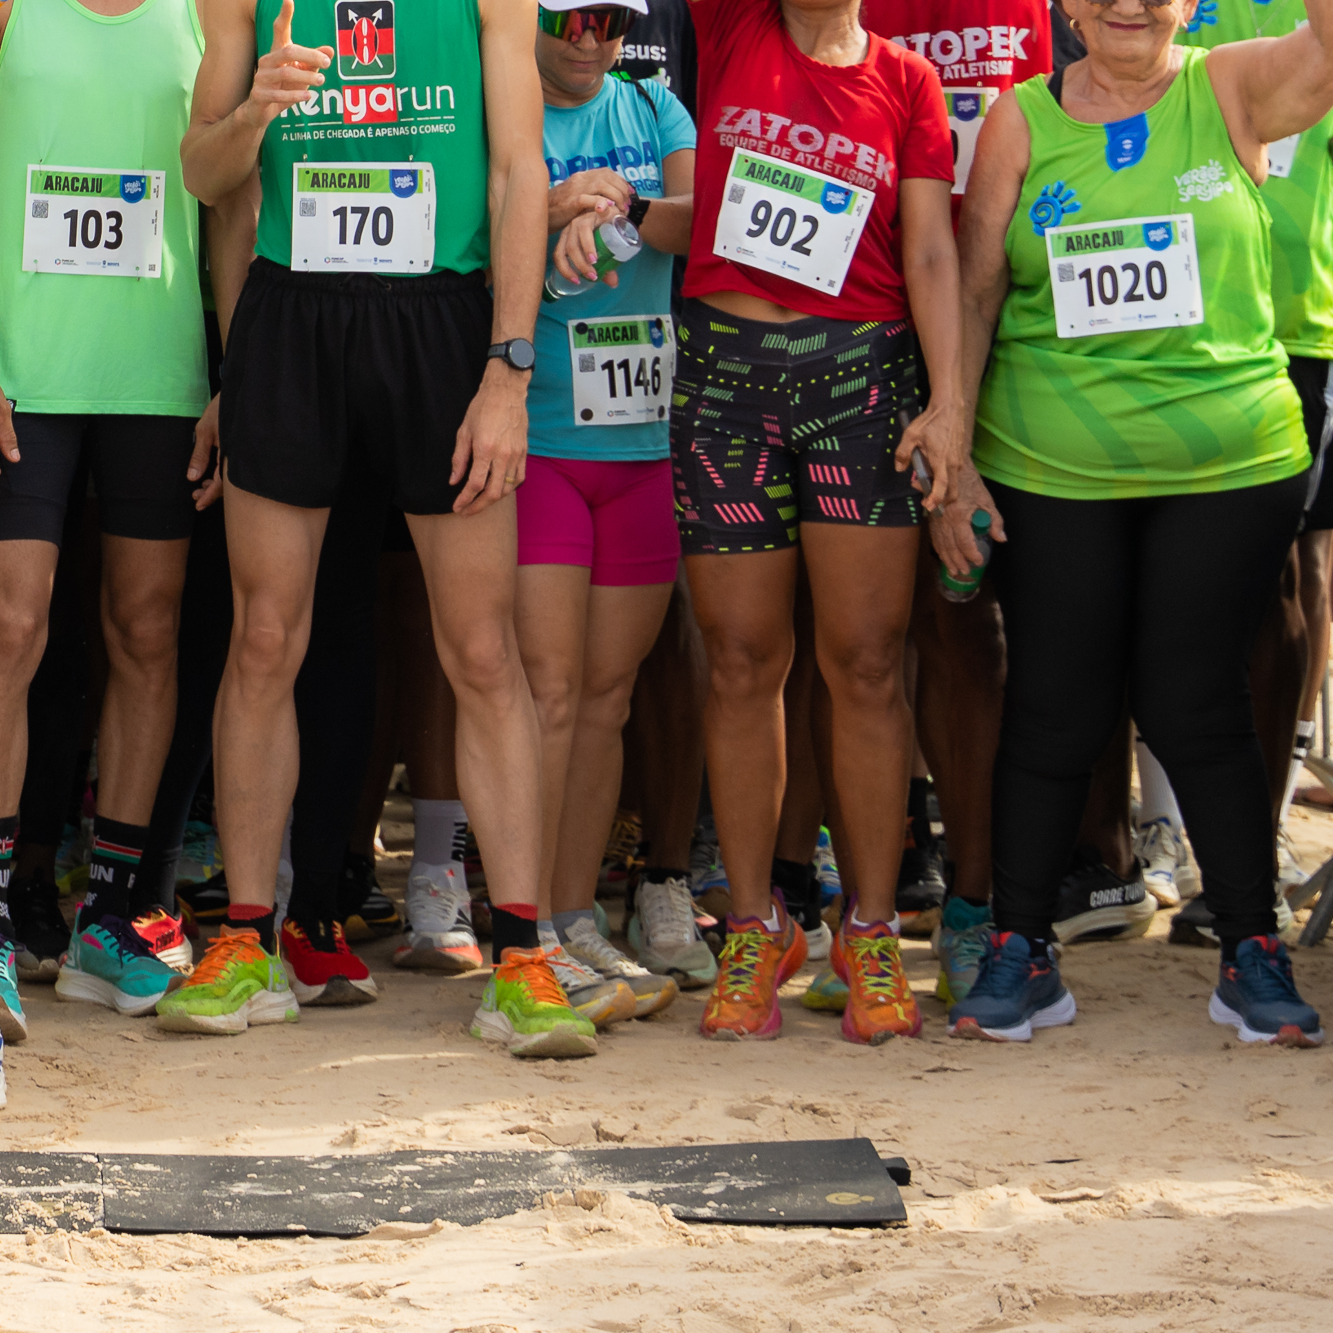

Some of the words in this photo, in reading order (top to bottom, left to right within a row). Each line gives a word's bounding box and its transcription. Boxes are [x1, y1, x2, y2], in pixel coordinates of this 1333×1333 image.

[890, 26, 1030, 64] ATOPEK
[282, 132, 289, 141] A
[290, 131, 312, 141] LINHA
[313, 130, 325, 140] DE
[326, 128, 366, 139] CHEGADA
[367, 126, 373, 138] É
[375, 126, 410, 137] APENAS
[410, 126, 416, 135] O
[418, 123, 455, 135] COMEÇO
[713, 105, 897, 188] ZATOPEK
[309, 172, 371, 190] ARACAJU
[719, 134, 769, 153] EQUIPE
[770, 143, 792, 159] DE
[794, 152, 878, 191] ATLETISMO
[745, 162, 806, 193] ARACAJU
[43, 174, 103, 194] ARACAJU
[63, 208, 124, 250] 103
[332, 205, 394, 247] 170
[745, 200, 819, 257] 902
[1066, 230, 1125, 252] ARACAJU
[1079, 260, 1168, 307] 1020
[586, 324, 639, 344] ARACAJU
[600, 356, 661, 398] 1146
